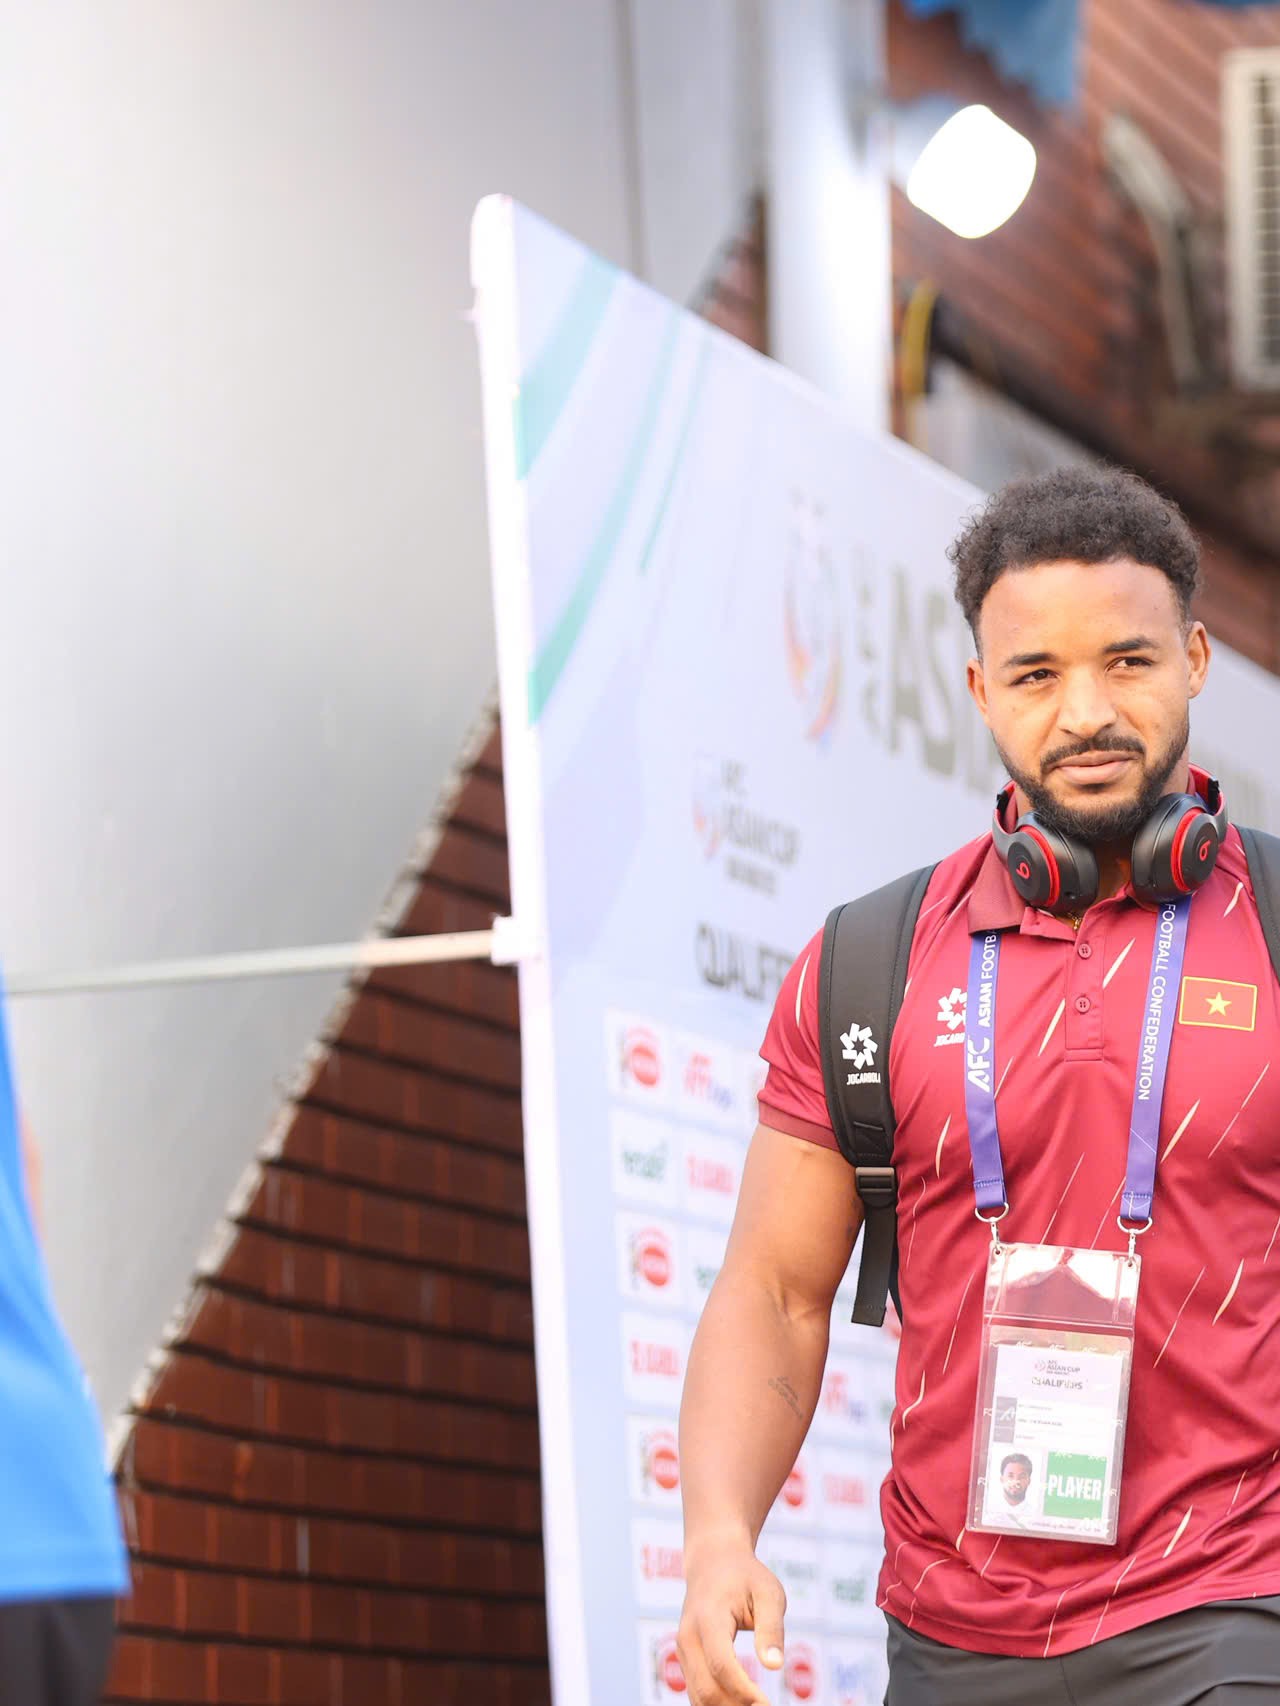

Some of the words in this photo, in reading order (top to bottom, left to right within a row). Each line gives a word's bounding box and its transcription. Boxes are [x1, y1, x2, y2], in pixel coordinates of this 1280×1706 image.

[981, 930, 998, 980] FOOTB
[1155, 903, 1176, 972] FOOTBALL
[977, 982, 993, 1028] ASIAN
[1138, 975, 1166, 1100] CONFEDERATION
[968, 1036, 991, 1093] AFC
[1047, 1473, 1103, 1502] PLAYER
